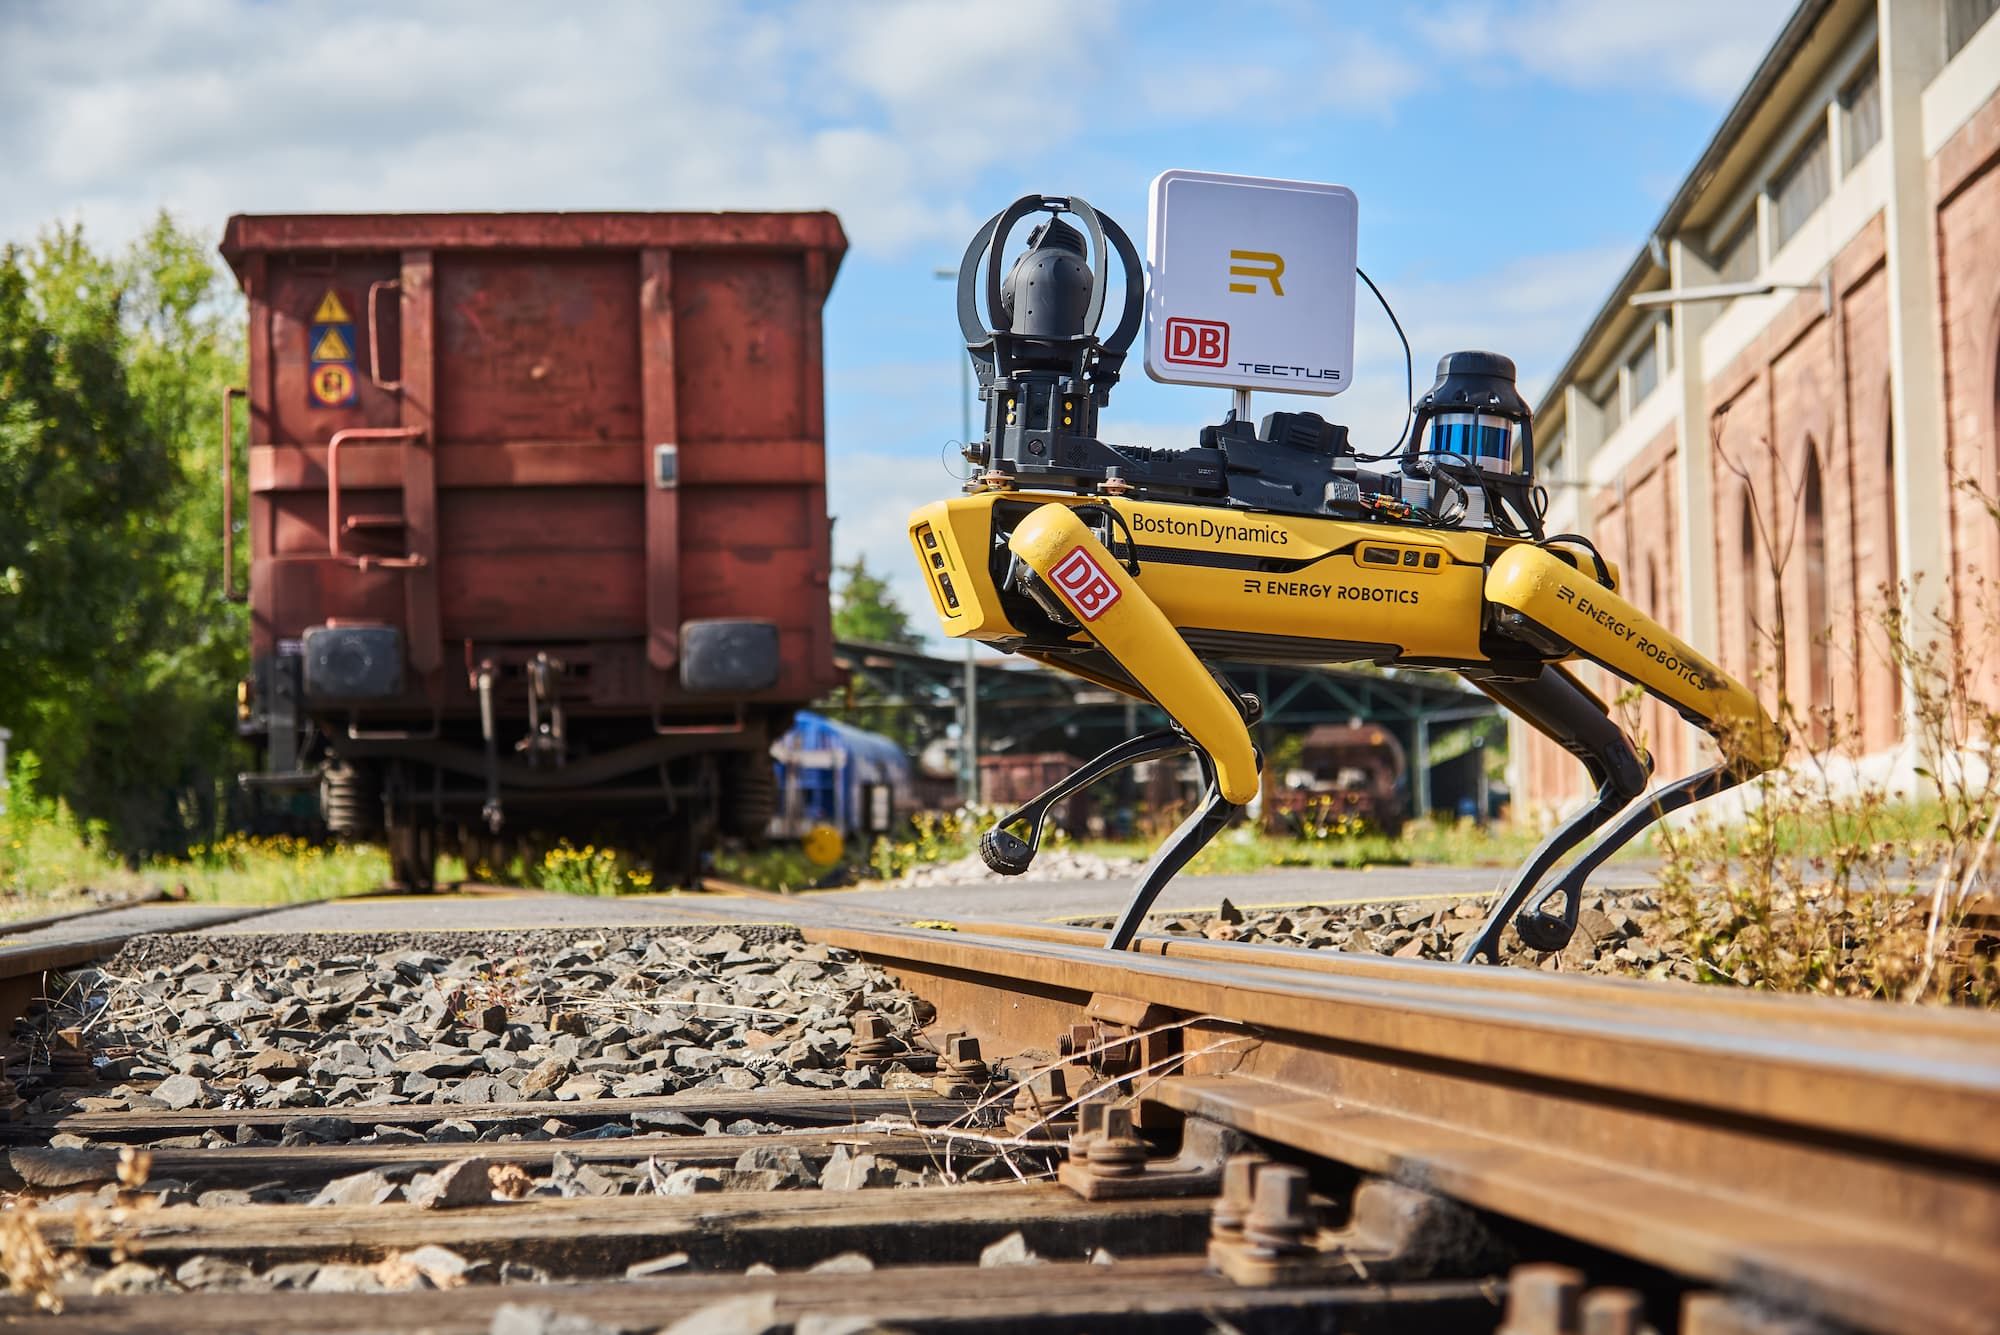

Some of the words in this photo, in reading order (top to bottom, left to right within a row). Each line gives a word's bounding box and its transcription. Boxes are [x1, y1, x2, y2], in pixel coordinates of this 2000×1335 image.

[1173, 325, 1221, 360] DB
[1238, 362, 1341, 380] TECTUS
[1057, 555, 1110, 611] DB
[1266, 581, 1333, 599] ENERGY
[1338, 585, 1419, 605] ROBOTICS
[1576, 598, 1636, 642] ENERGY
[1636, 637, 1706, 692] ROBOTICS
